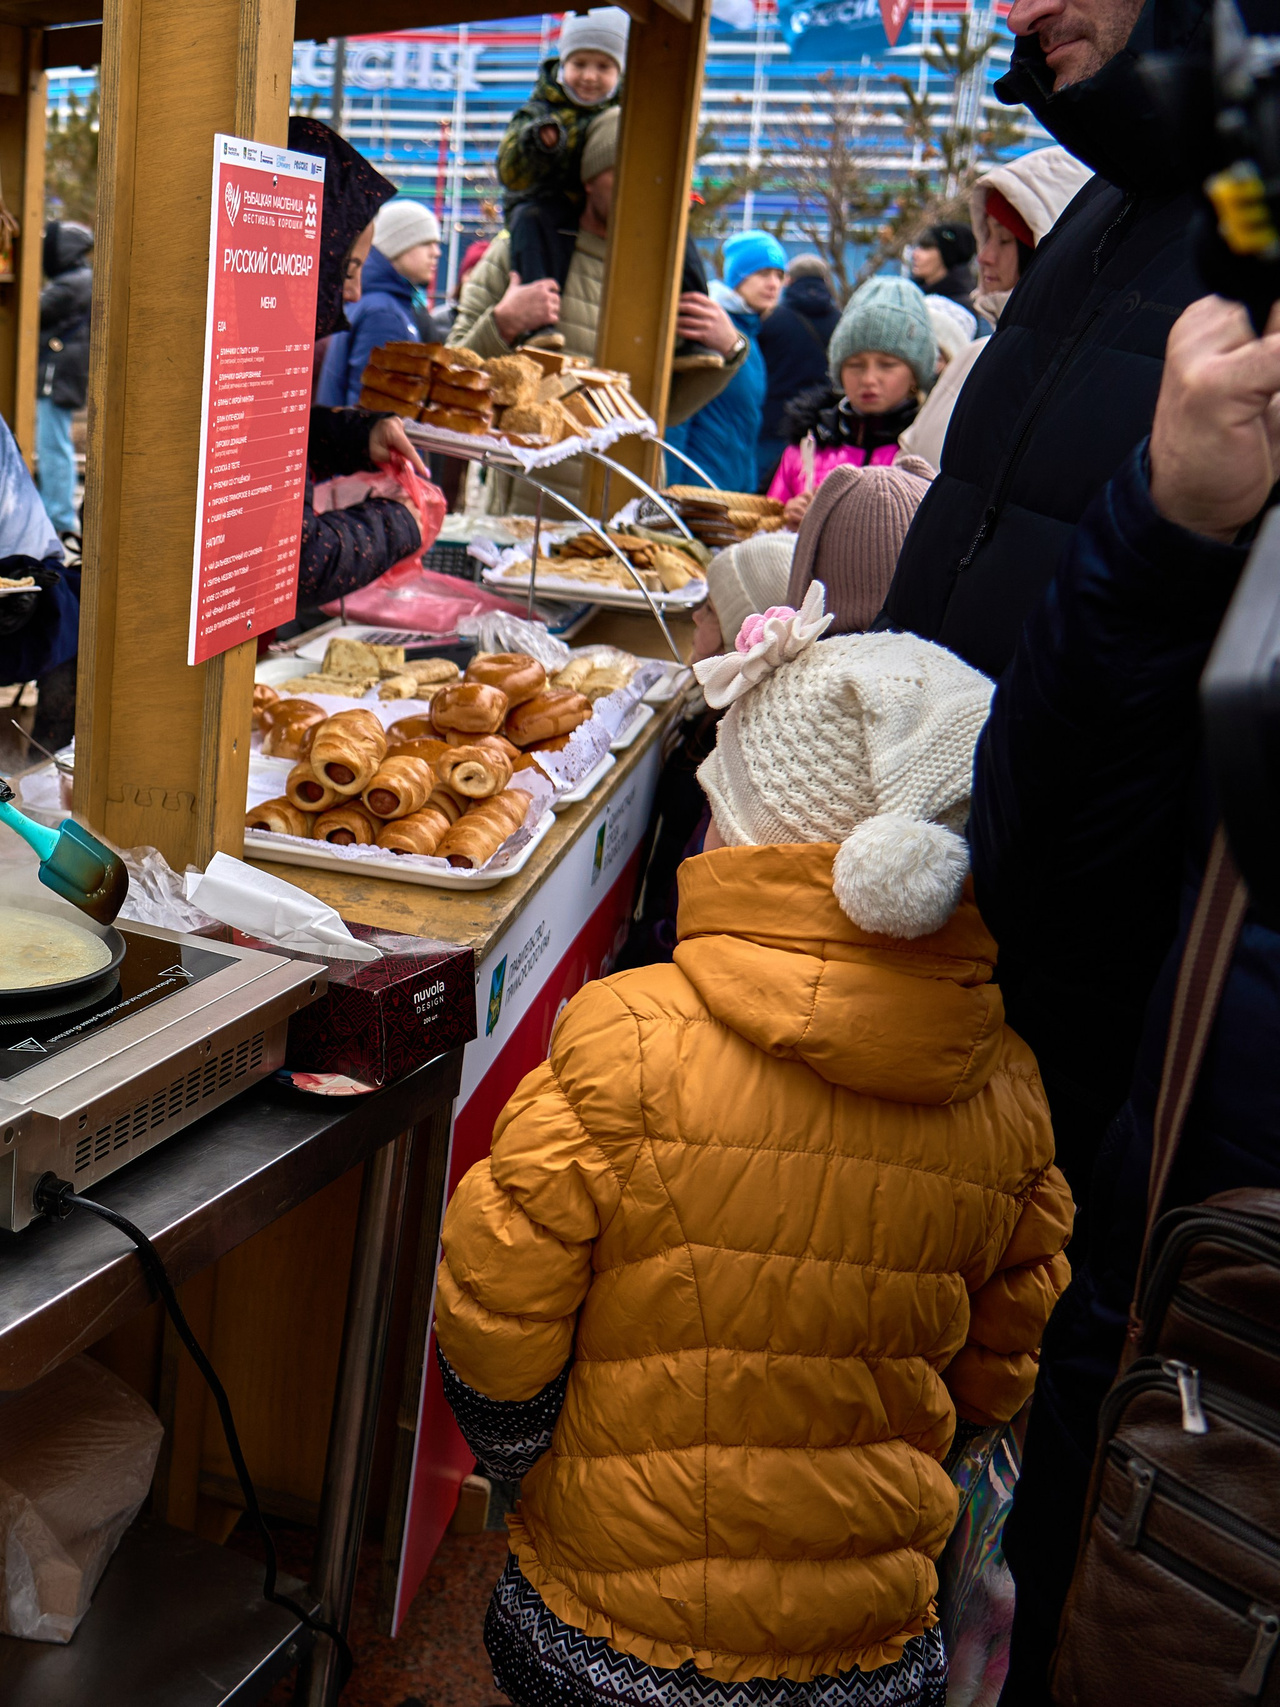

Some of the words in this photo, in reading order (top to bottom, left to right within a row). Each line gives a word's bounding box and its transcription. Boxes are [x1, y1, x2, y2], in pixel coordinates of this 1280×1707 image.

[244, 190, 272, 208] РЫБАЦКАЯ
[273, 196, 304, 212] МАСЛЕНИЦА
[243, 214, 276, 227] ФЕСТИВАЛЬ
[278, 218, 302, 230] КОРЮШКИ
[224, 246, 268, 274] РУССКИЙ
[270, 252, 312, 276] САМОВАР
[260, 296, 276, 309] МЕНЮ
[218, 322, 226, 332] ЕДА
[414, 980, 444, 1004] nuvola
[416, 995, 444, 1014] DESIGN
